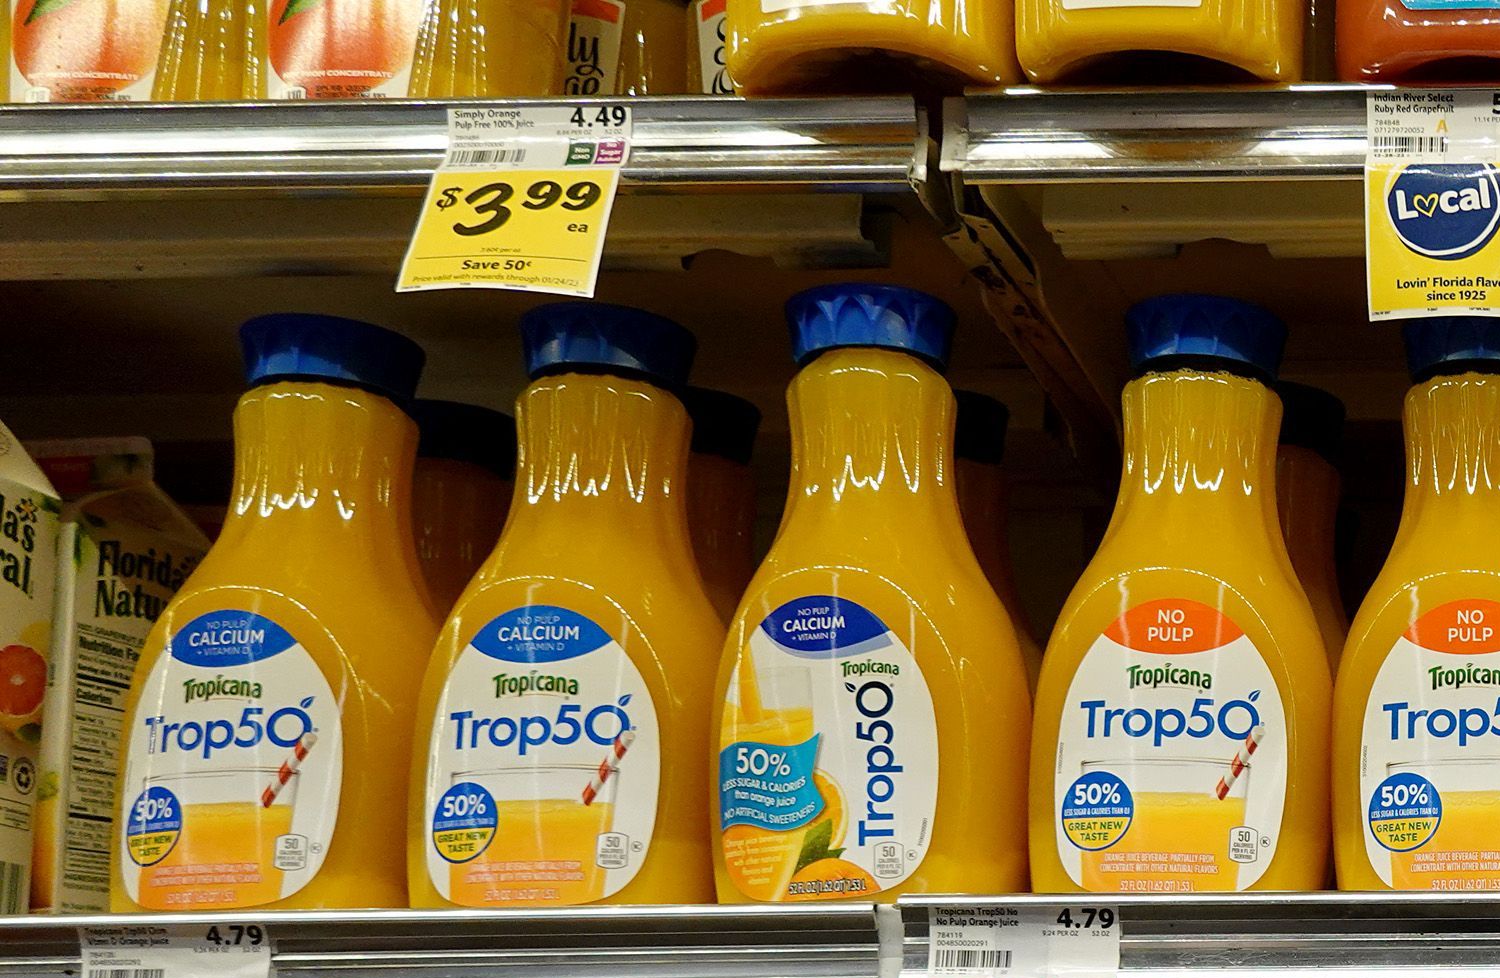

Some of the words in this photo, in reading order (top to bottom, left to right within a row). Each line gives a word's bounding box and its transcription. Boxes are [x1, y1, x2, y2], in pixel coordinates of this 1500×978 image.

[1374, 93, 1402, 101] Indian
[1404, 93, 1425, 101] River
[455, 110, 485, 118] Simply
[488, 110, 520, 118] Orange
[570, 106, 626, 127] 4.49
[1374, 105, 1394, 114] Ruby
[1396, 105, 1411, 113] Red
[1413, 105, 1454, 114] Grapefruit
[567, 223, 588, 233] ea
[462, 260, 499, 270] Save
[1397, 278, 1430, 289] Lovin'
[1433, 278, 1473, 287] Florida
[1427, 291, 1455, 301] since
[1459, 291, 1486, 300] 1925
[783, 616, 846, 632] CALCIUM
[1158, 610, 1184, 624] NO
[189, 629, 265, 647] CALCIUM
[1148, 628, 1193, 641] PULP
[841, 660, 899, 677] Tropicana
[1126, 663, 1212, 689] Tropicana
[183, 675, 263, 703] Tropicana
[1081, 698, 1260, 746] Trop50
[146, 707, 312, 759] Trop50
[736, 748, 790, 776] 50%
[855, 681, 904, 846] Trop50
[1057, 908, 1114, 928] 4.79
[206, 926, 262, 945] 4.79
